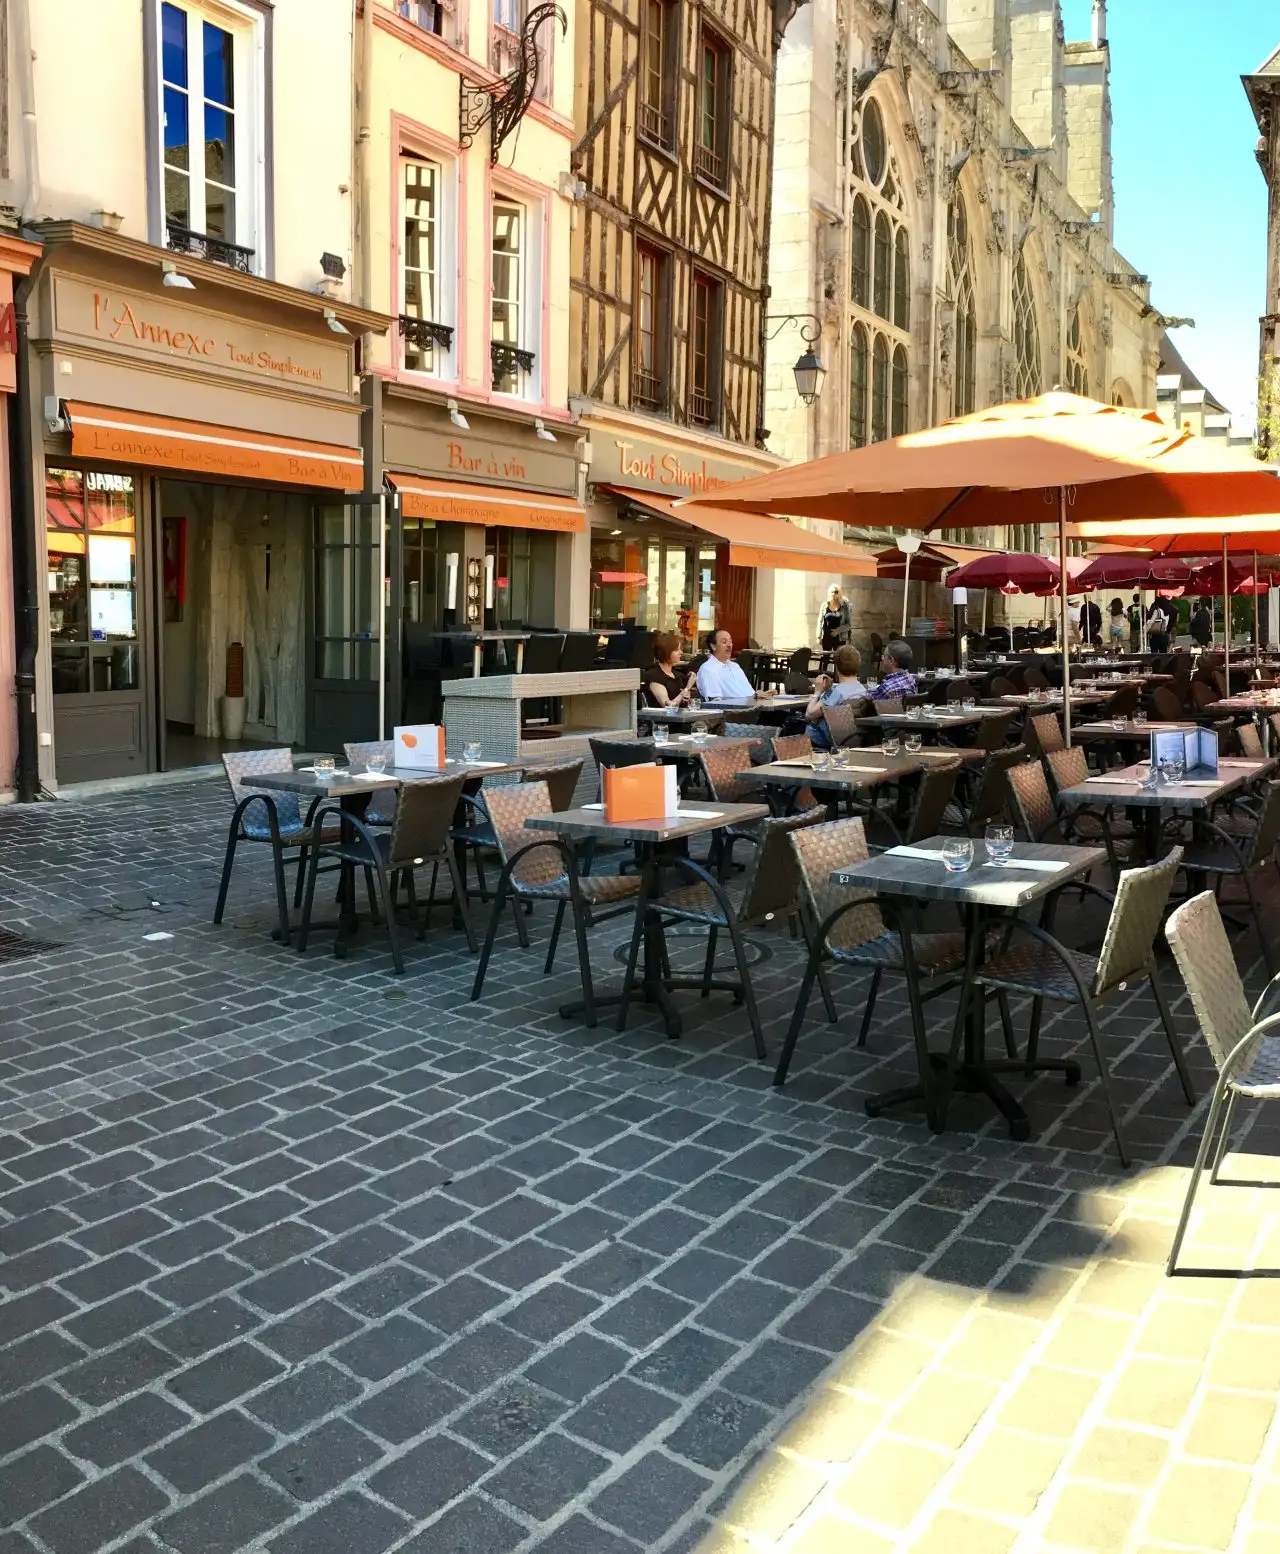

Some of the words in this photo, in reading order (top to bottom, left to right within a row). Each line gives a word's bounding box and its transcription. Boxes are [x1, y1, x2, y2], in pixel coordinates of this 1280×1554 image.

[226, 343, 255, 365] Tout
[256, 351, 323, 381] Simplement
[288, 458, 317, 476] Bar
[331, 464, 352, 482] Vin
[447, 442, 482, 471] Bar
[487, 451, 498, 475] à
[503, 459, 526, 479] vin
[615, 440, 656, 480] Tout
[411, 495, 429, 512] Bar
[441, 499, 500, 521] Champagne
